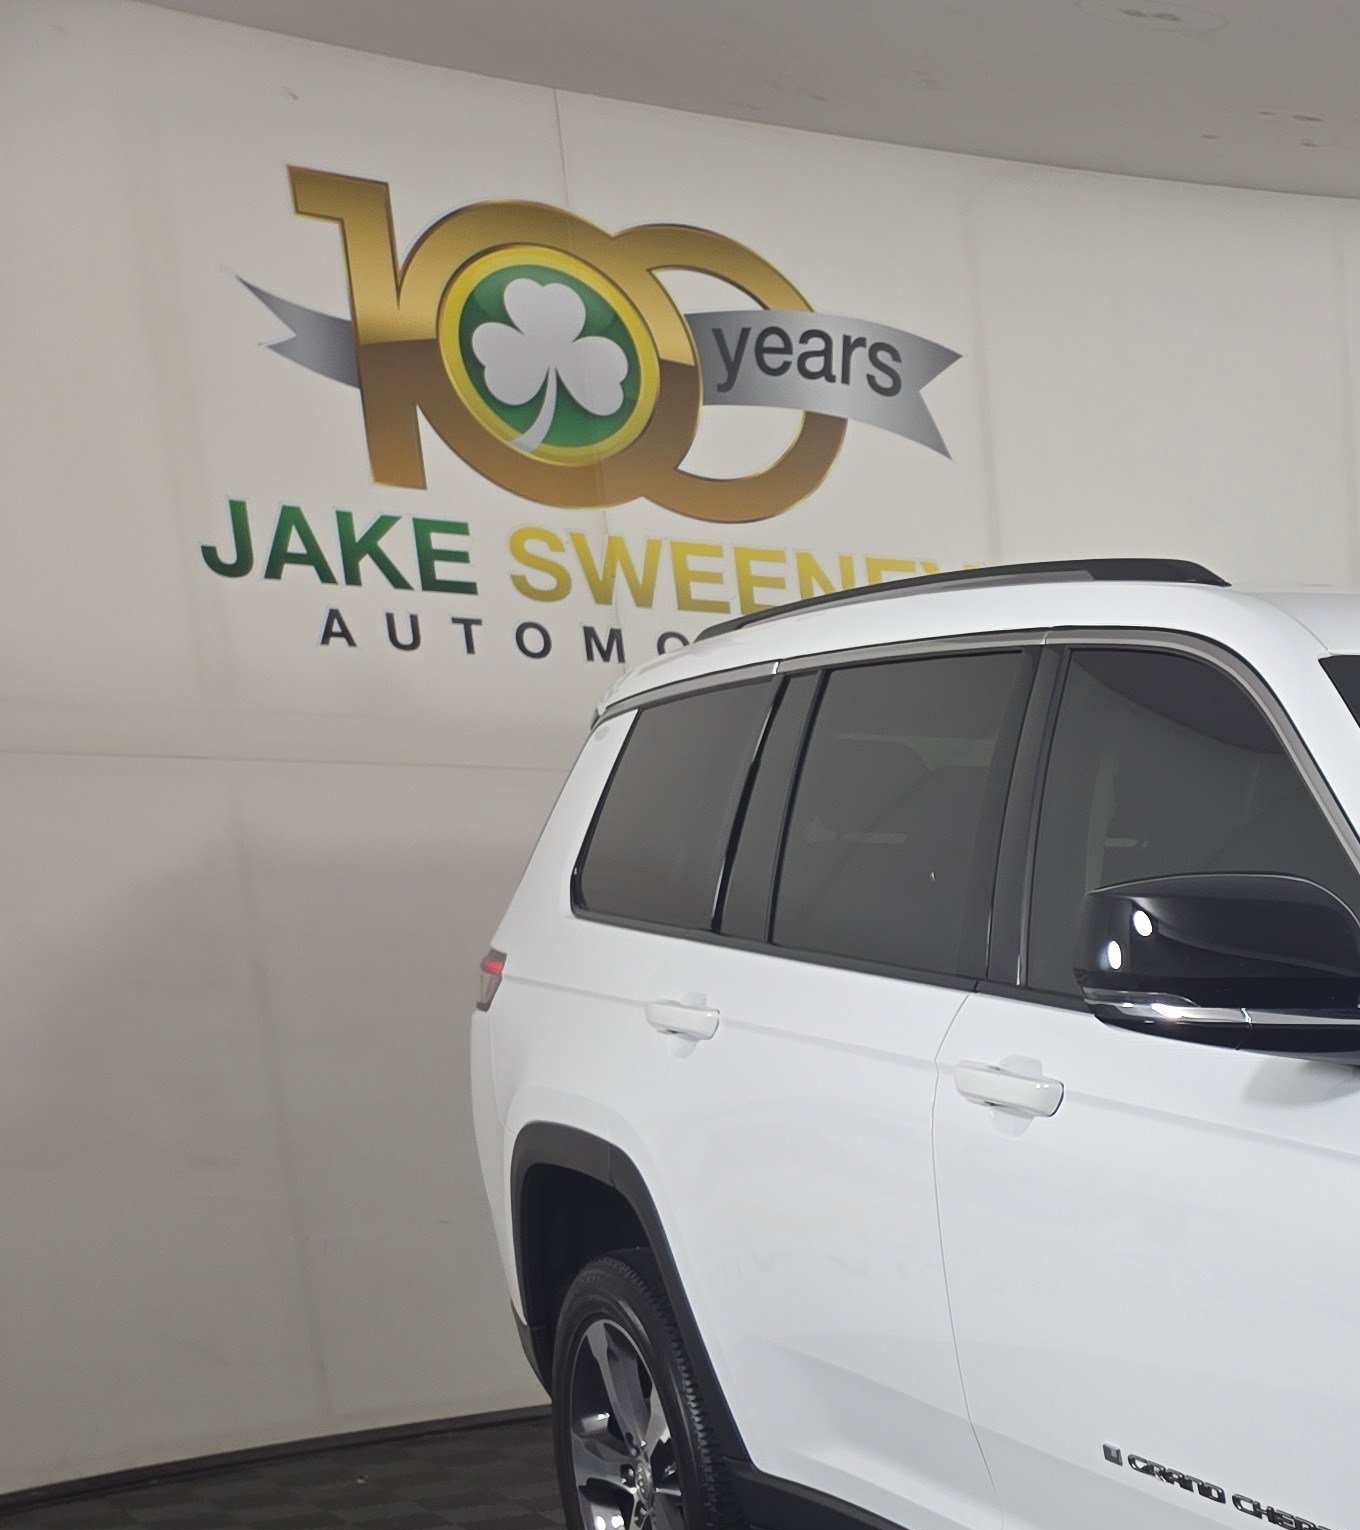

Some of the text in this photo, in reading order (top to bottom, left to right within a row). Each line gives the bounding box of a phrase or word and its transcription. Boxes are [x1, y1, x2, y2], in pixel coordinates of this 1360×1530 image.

[287, 164, 904, 522] 100 years
[200, 499, 982, 614] JAKE SWEEN
[321, 608, 690, 663] AUTOMO
[1128, 1453, 1227, 1504] GRAND
